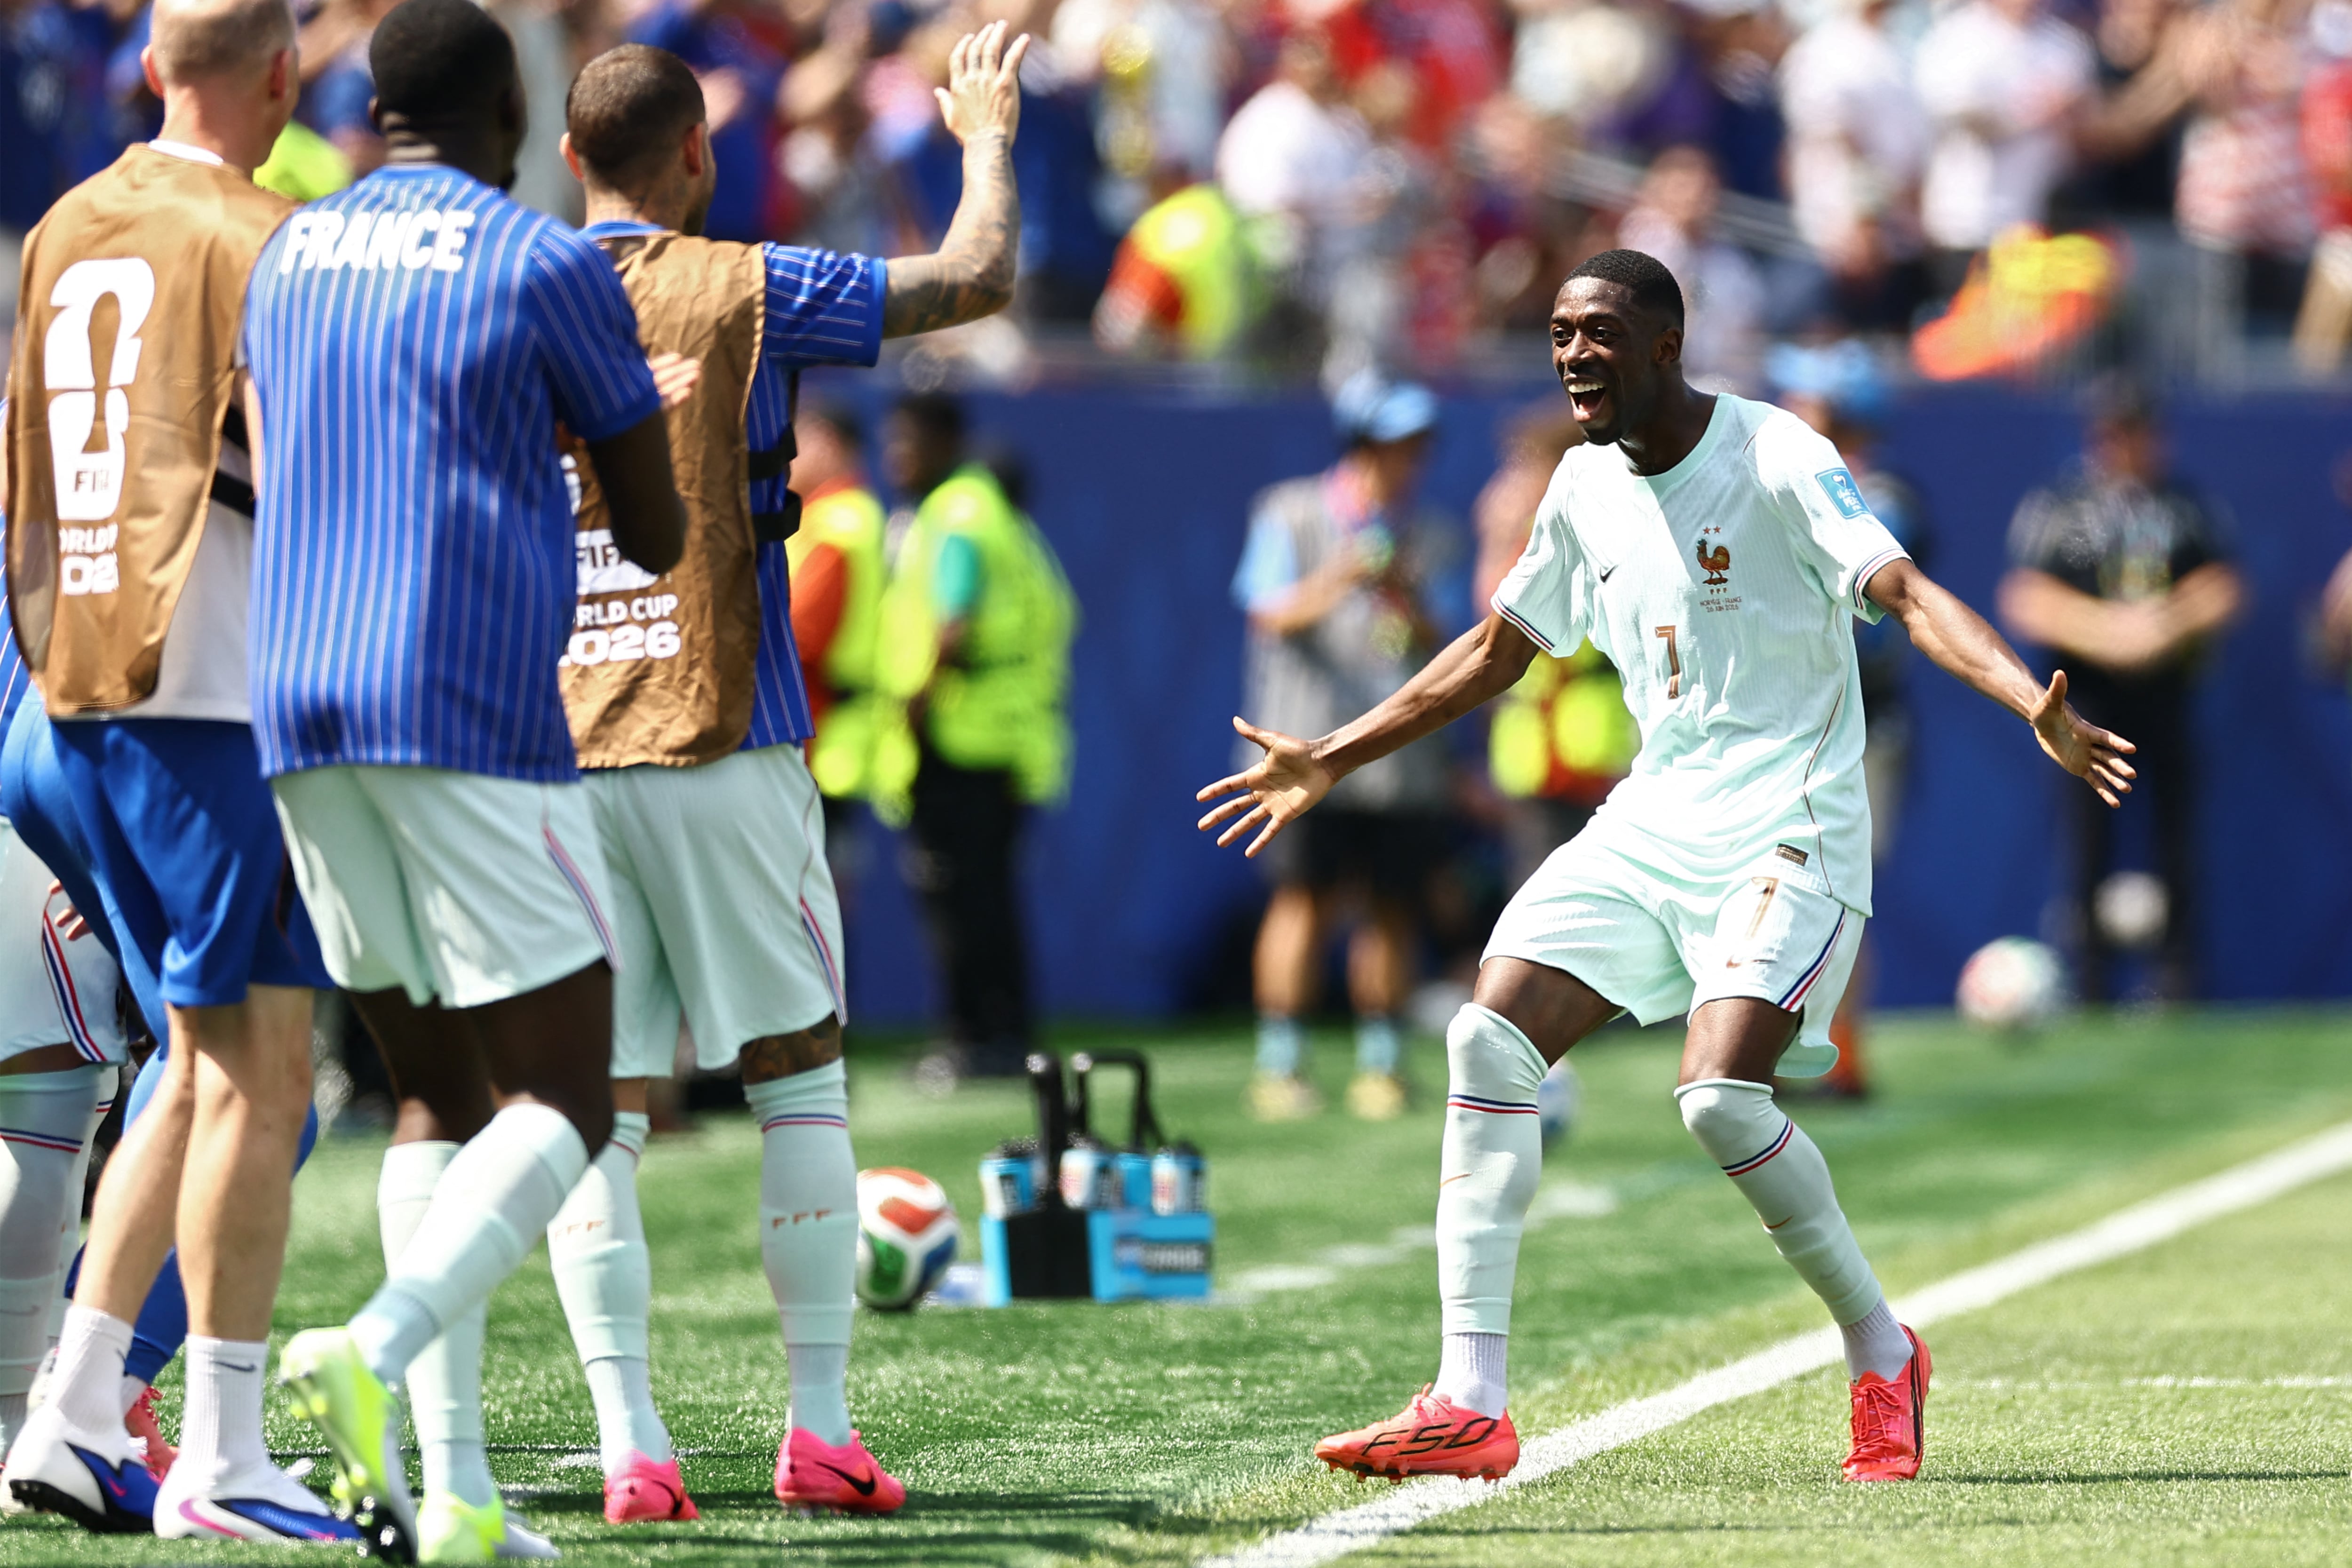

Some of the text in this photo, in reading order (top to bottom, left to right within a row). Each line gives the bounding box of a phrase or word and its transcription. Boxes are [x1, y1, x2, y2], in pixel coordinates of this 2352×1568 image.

[281, 210, 475, 274] FRANCE
[572, 593, 678, 627] RLD CUP
[557, 621, 681, 667] 026
[1654, 625, 1681, 700] 7
[1747, 876, 1779, 939] 7
[1360, 1417, 1500, 1457] F50
